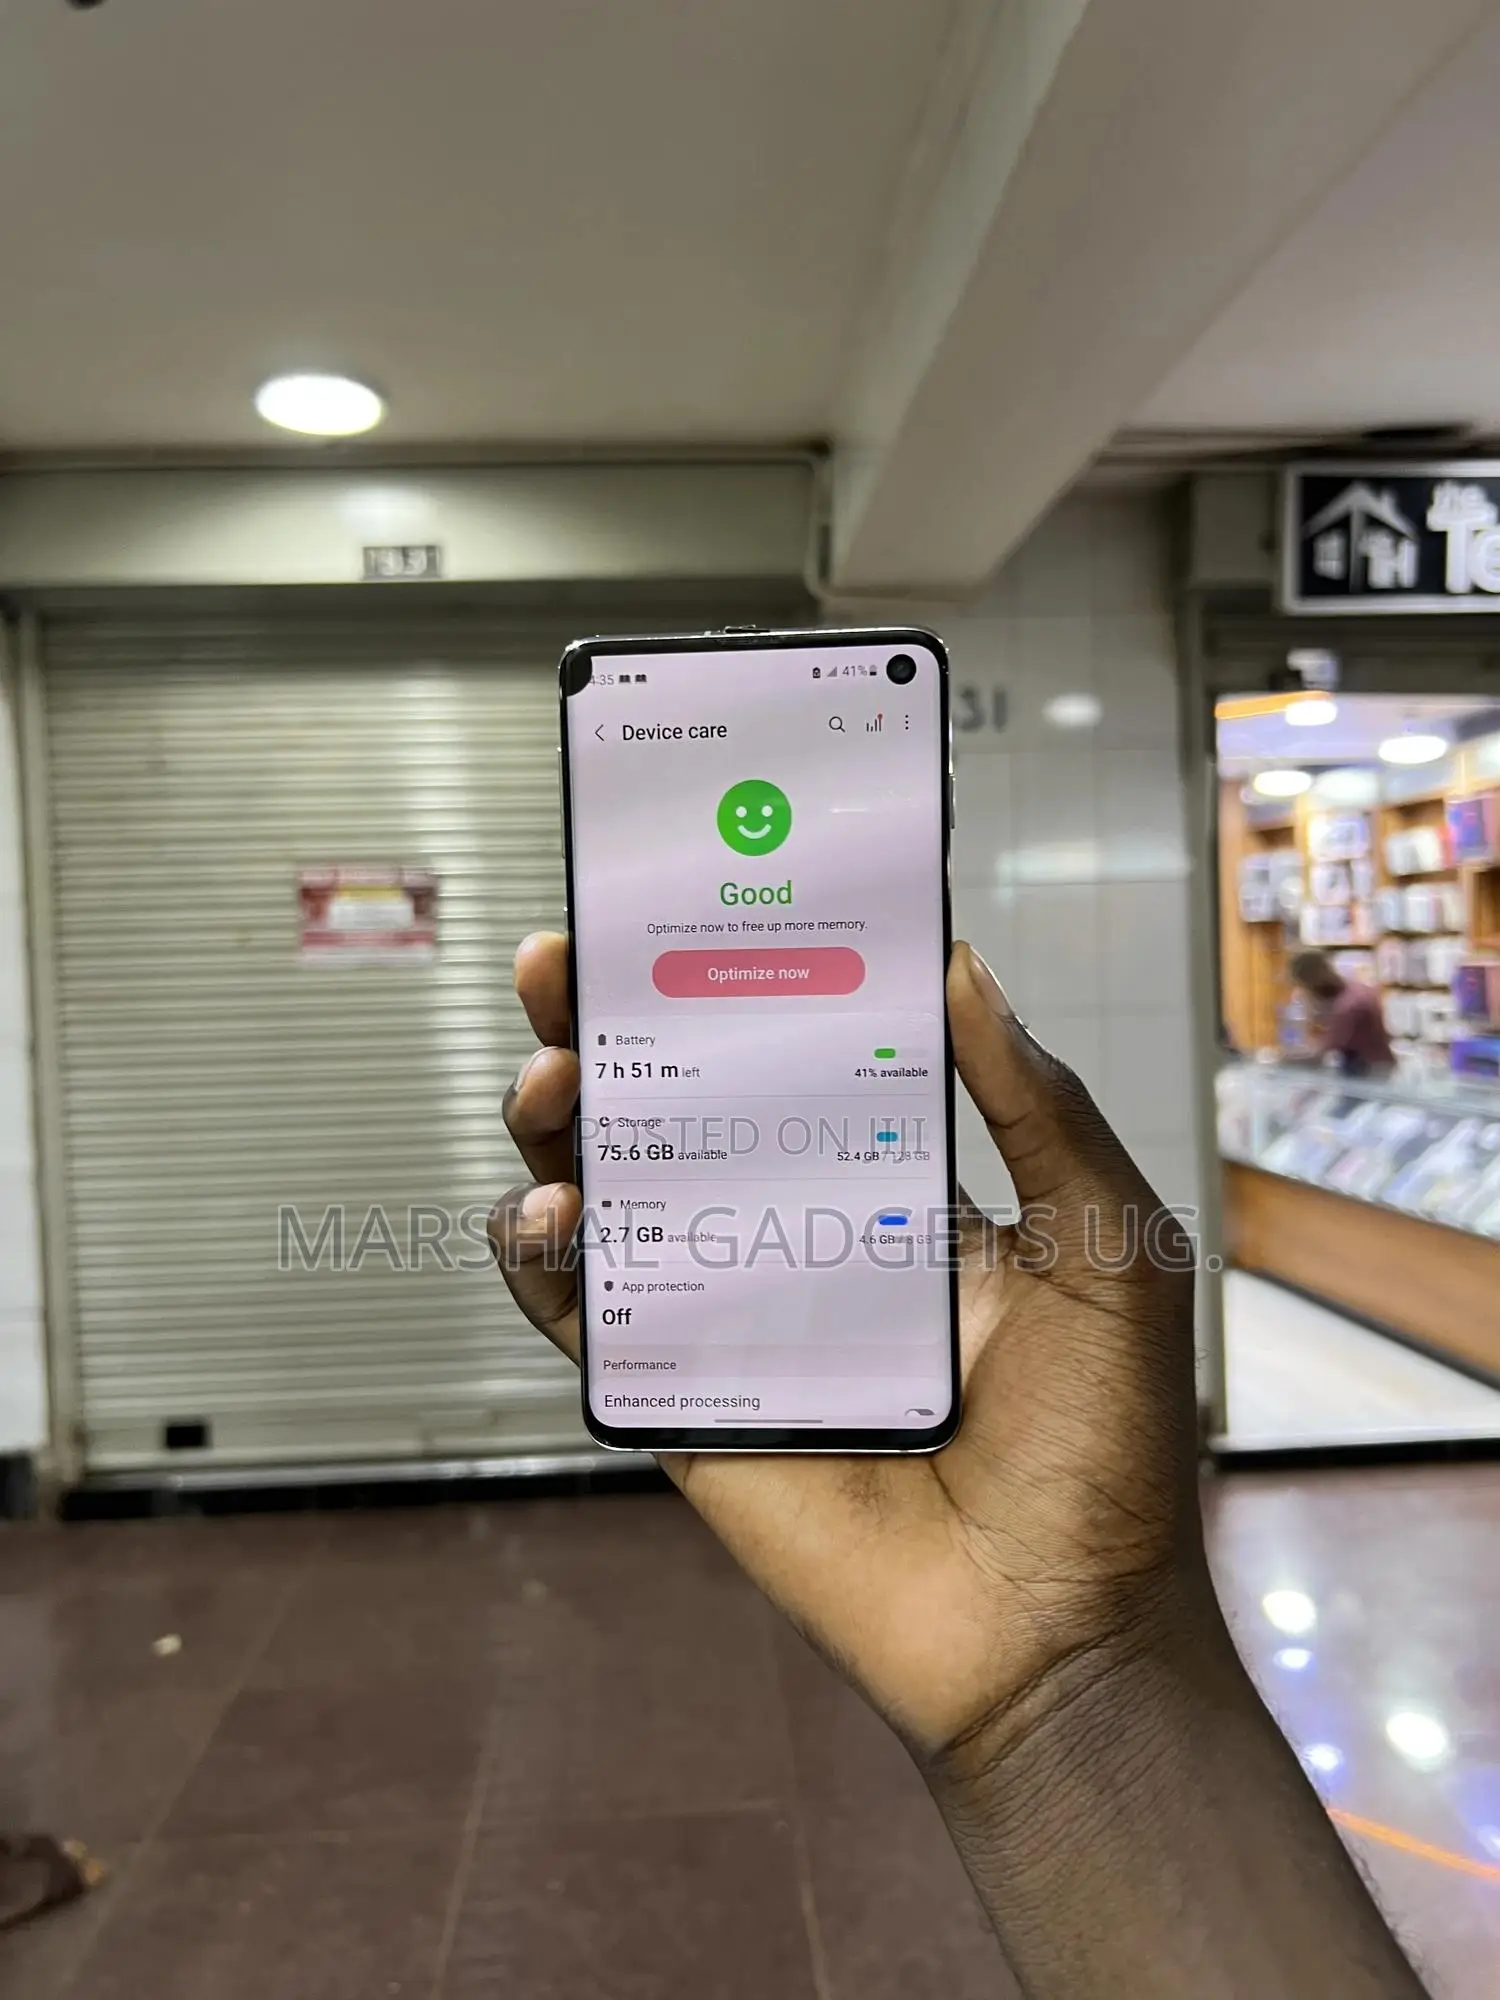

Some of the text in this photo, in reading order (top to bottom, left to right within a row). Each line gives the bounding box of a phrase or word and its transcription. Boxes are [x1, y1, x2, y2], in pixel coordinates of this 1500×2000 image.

[842, 665, 868, 677] 41%
[622, 723, 728, 741] Device care
[719, 880, 793, 906] Good
[647, 919, 867, 935] Optimize now to free up more memory.
[707, 965, 810, 983] Optimize now
[615, 1034, 656, 1047] Battery
[595, 1062, 700, 1079] 7 h 51 m left
[854, 1066, 928, 1078] 41% available
[617, 1116, 662, 1129] Storage
[598, 1144, 728, 1161] 75.6 GB available
[837, 1151, 861, 1161] 52.4
[864, 1151, 880, 1161] GB
[620, 1198, 666, 1211] Memory
[600, 1227, 716, 1244] 2.7 GB available
[859, 1235, 876, 1245] 4.6
[879, 1234, 895, 1245] GB
[622, 1280, 705, 1294] App protection
[602, 1308, 632, 1326] Off
[603, 1359, 677, 1370] Performance
[604, 1394, 760, 1410] Enhanced processing
